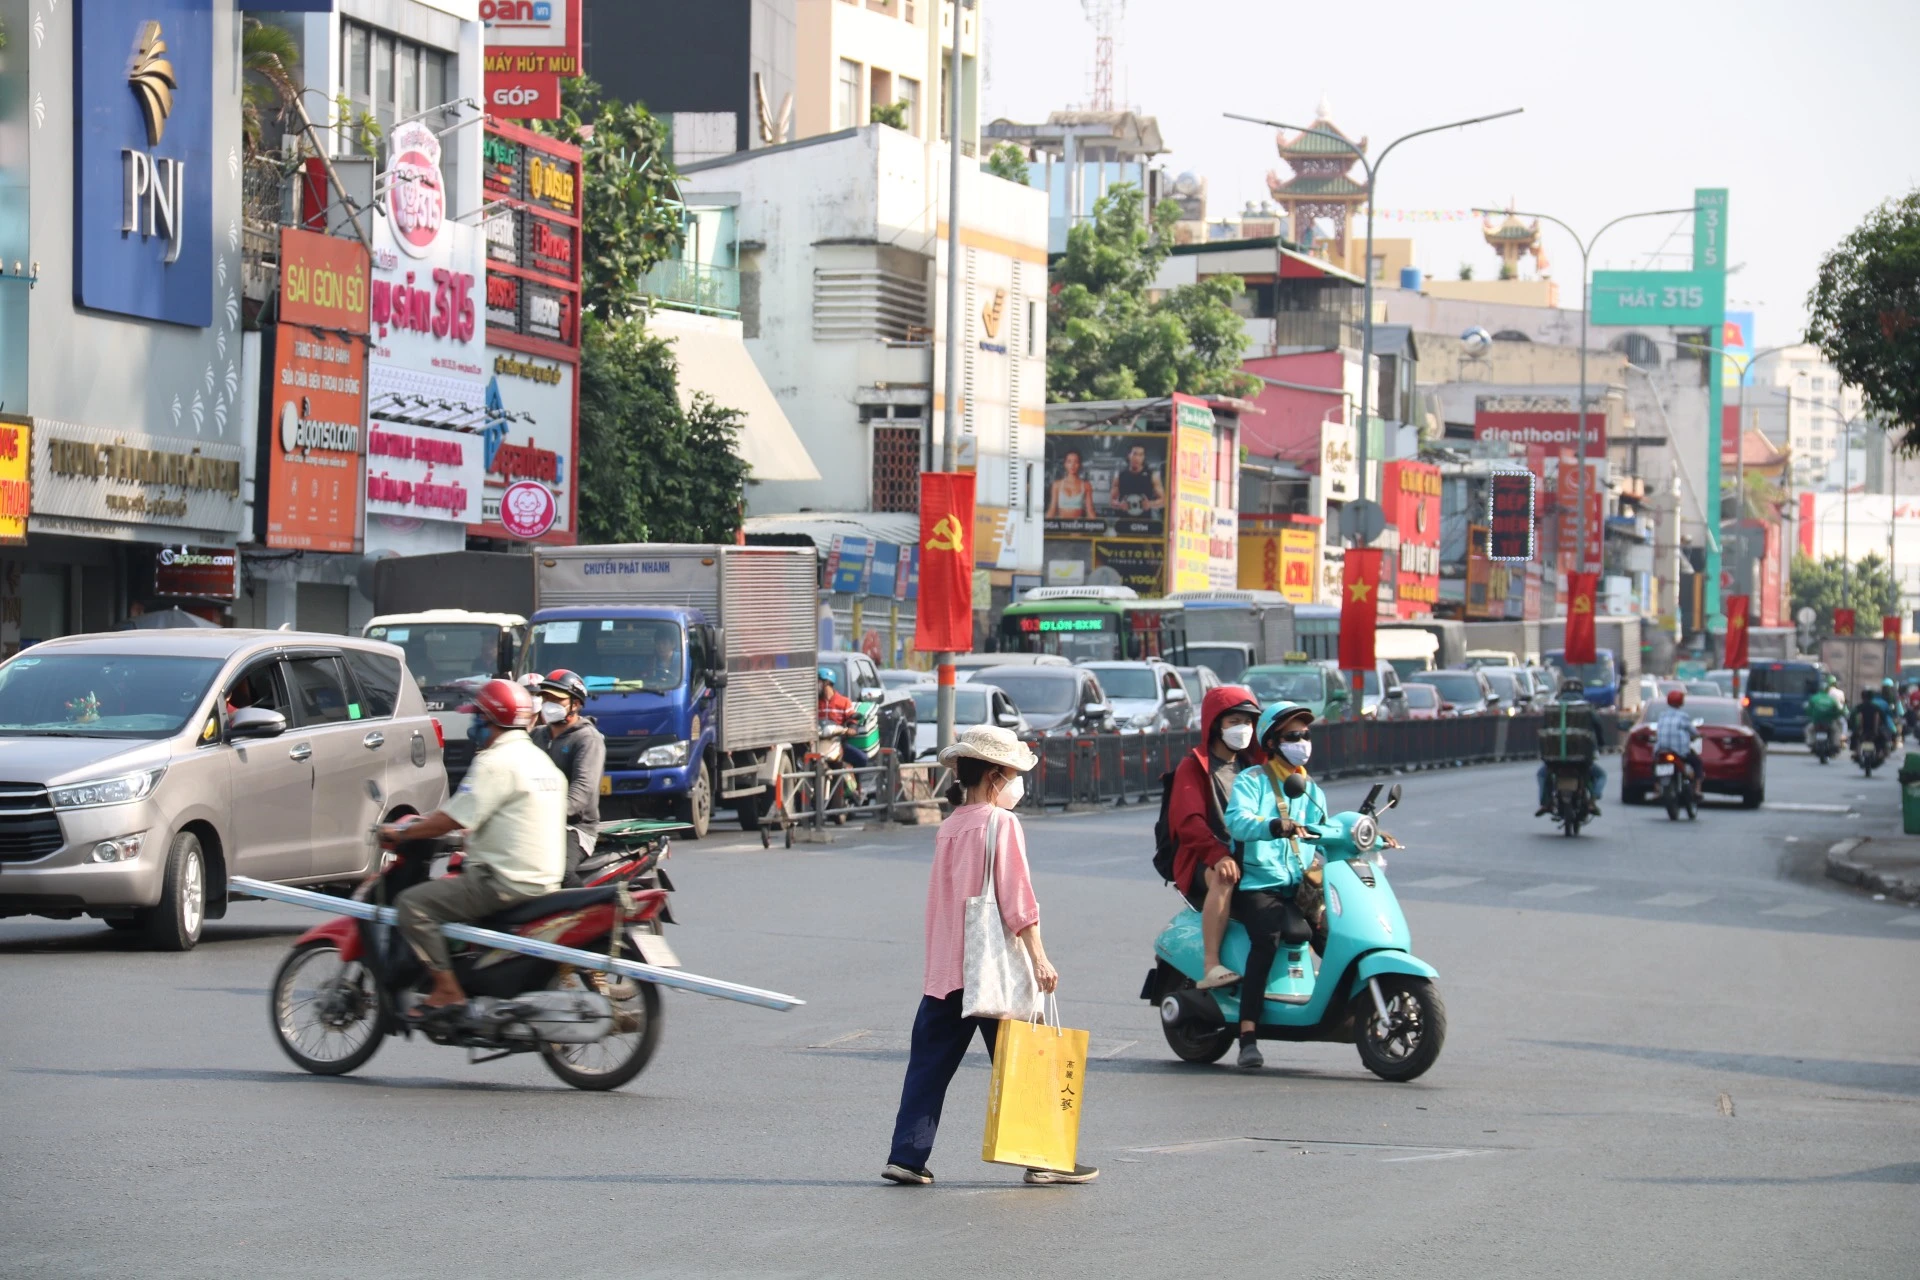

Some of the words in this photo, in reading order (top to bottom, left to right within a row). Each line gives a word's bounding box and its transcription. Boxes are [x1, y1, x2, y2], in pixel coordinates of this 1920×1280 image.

[517, 51, 545, 73] HÚT
[493, 85, 539, 106] GÓP
[123, 149, 184, 262] PNJ
[313, 262, 343, 310] GÒN
[1662, 287, 1703, 307] 315
[432, 268, 475, 343] 315
